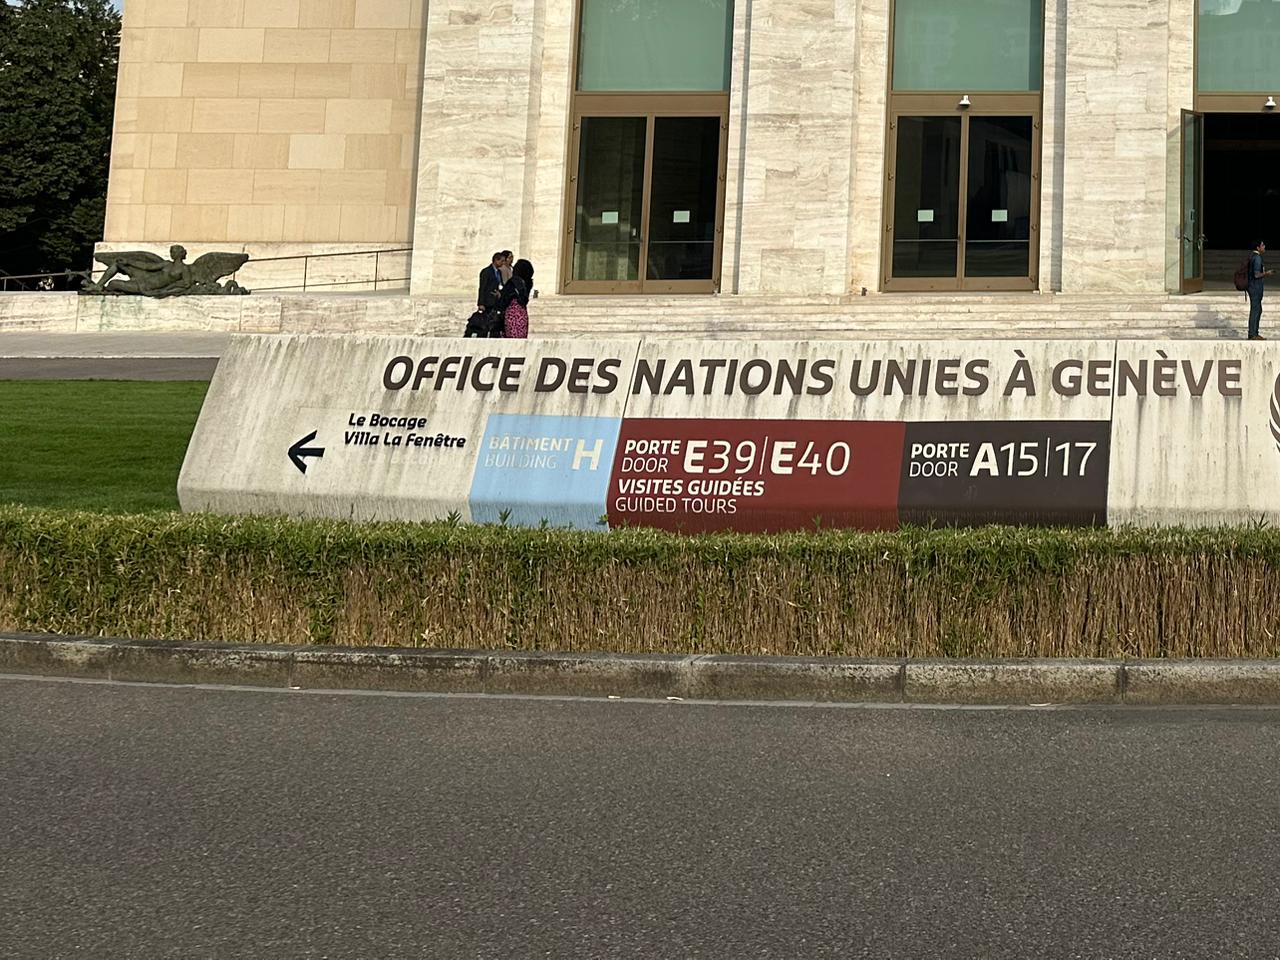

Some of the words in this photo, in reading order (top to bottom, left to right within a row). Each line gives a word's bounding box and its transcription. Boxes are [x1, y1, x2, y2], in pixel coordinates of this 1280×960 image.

[383, 356, 526, 392] OFFICE
[534, 357, 622, 394] DES
[632, 358, 836, 396] NATIONS
[850, 359, 990, 396] UNIES
[1002, 349, 1037, 396] À
[1051, 350, 1243, 397] GENÈVE
[348, 413, 366, 427] Le
[369, 413, 427, 430] Bocage
[344, 431, 380, 446] Villa
[383, 432, 401, 447] La
[405, 433, 467, 448] Fenêtre
[624, 439, 681, 456] PORTE
[488, 433, 573, 452] BÂTIMENT
[571, 439, 604, 471] H
[911, 442, 970, 459] PORTE
[484, 453, 558, 469] BUILDING
[621, 457, 669, 473] DOOR
[909, 462, 958, 477] DOOR
[618, 478, 684, 495] VISITES
[687, 476, 765, 497] GUIDÉES
[615, 497, 677, 513] GUIDED
[681, 498, 738, 514] TOURS
